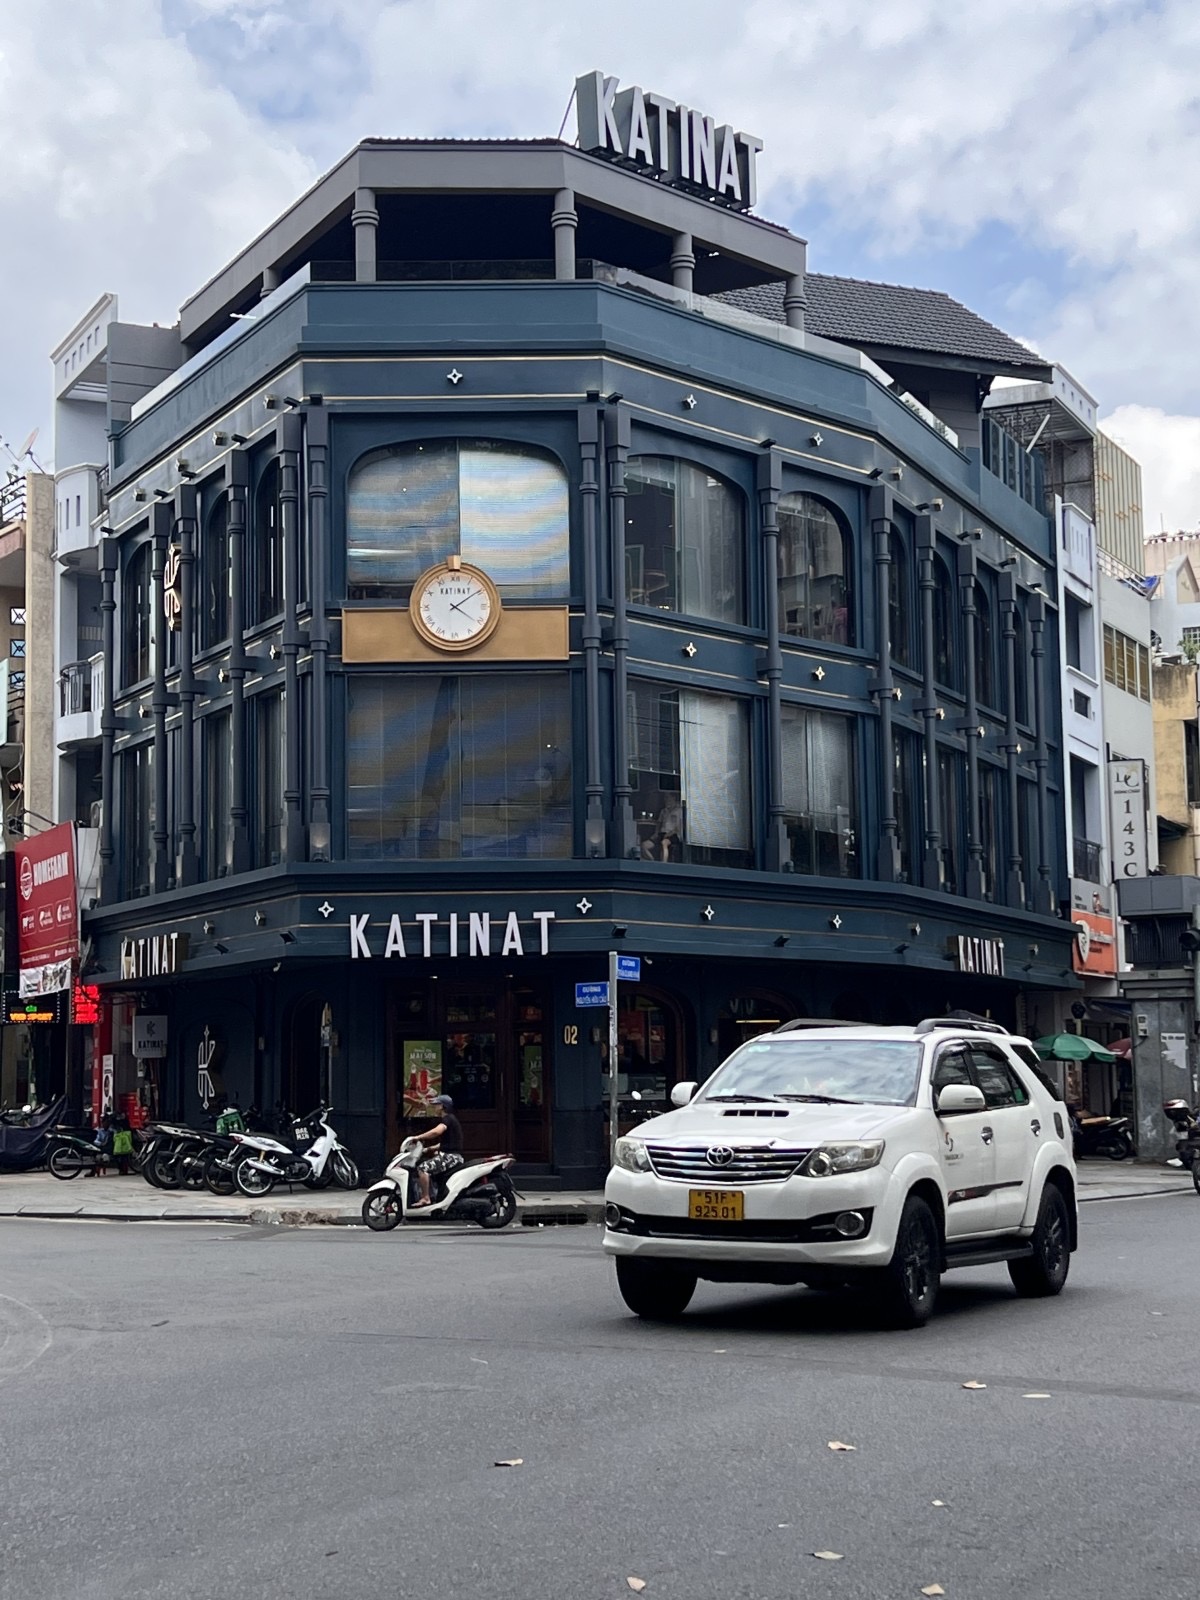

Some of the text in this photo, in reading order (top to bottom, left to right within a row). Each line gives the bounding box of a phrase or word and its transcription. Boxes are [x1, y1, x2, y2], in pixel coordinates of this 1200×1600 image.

[577, 70, 763, 207] KATINAT
[440, 587, 471, 595] KATINAT
[1122, 798, 1138, 878] 143C
[32, 851, 69, 887] HOMEFARM
[350, 911, 556, 959] KATINAT
[120, 932, 178, 980] KATINAT
[958, 935, 1005, 976] KATINAT
[138, 1040, 164, 1048] KATINAT
[564, 1026, 578, 1044] 02
[704, 1191, 727, 1204] 51F
